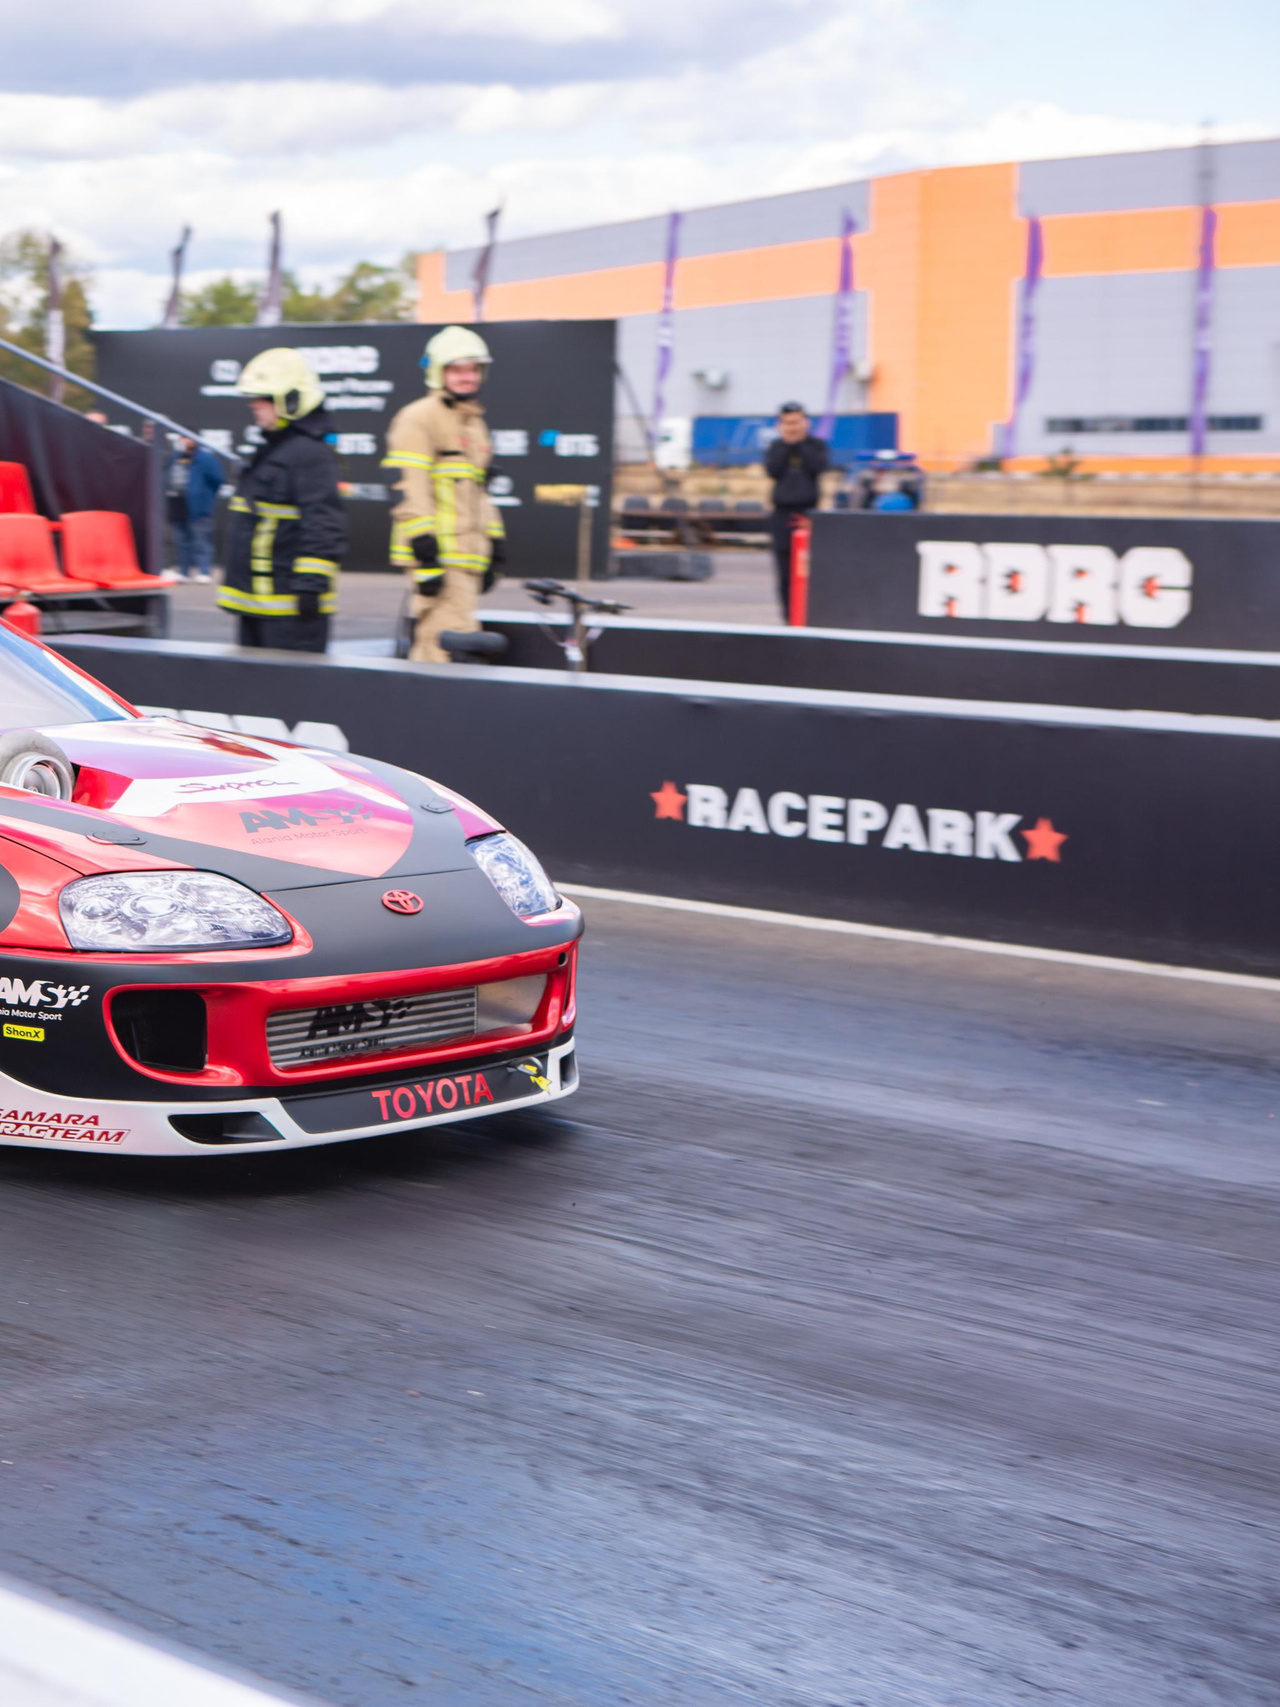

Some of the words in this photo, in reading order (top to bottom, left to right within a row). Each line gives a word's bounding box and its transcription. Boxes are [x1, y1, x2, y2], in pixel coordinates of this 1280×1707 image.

[916, 540, 1194, 628] RDRC
[685, 783, 1023, 862] RACEPARK
[11, 1008, 37, 1019] Motor
[38, 1011, 63, 1021] Sport
[371, 1072, 494, 1121] TOYOTA
